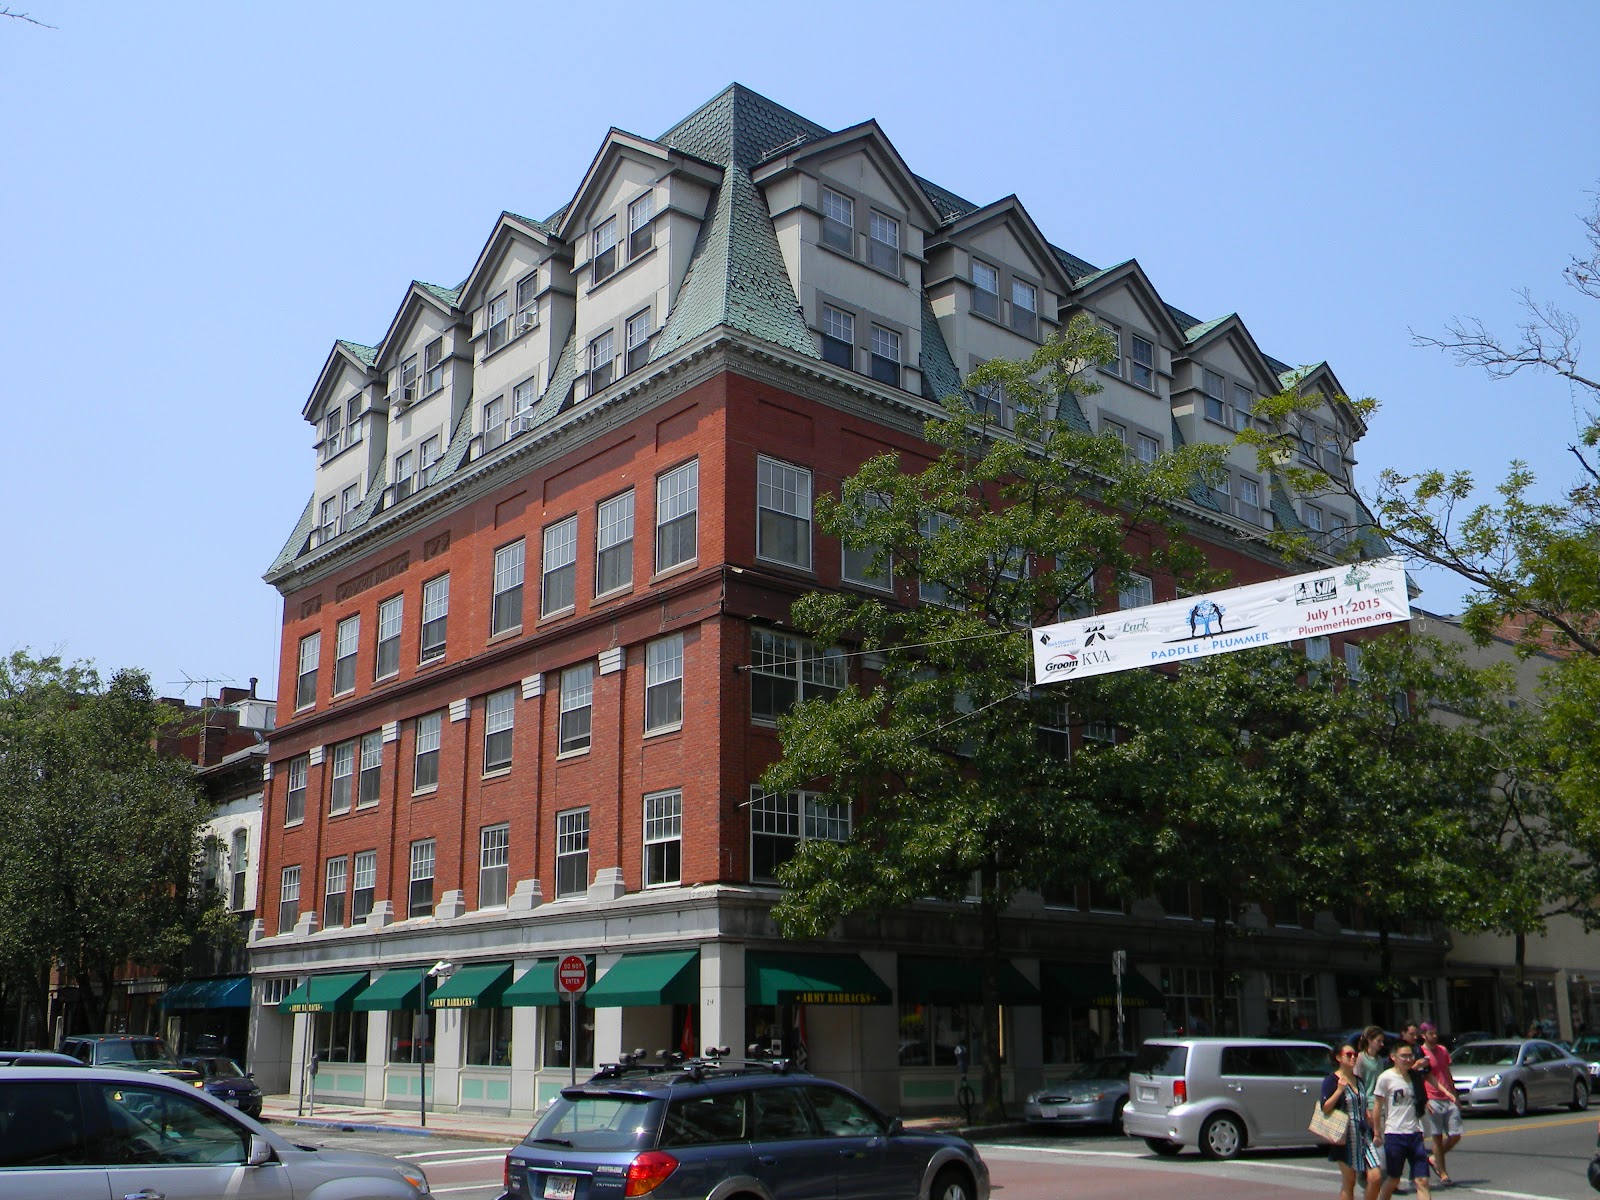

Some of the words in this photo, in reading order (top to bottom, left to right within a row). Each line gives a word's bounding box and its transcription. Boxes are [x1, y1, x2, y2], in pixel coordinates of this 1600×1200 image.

[1363, 579, 1394, 591] Plummer
[1374, 585, 1395, 595] Home
[1306, 609, 1329, 622] July
[1332, 604, 1349, 616] 11,
[1351, 597, 1381, 613] 2015
[1122, 617, 1149, 633] Lark
[1298, 611, 1393, 636] PlummerHome.org
[1151, 643, 1200, 660] PADDLE
[1212, 631, 1270, 650] PLUMMER
[1081, 650, 1111, 666] KVA
[1045, 660, 1079, 672] Groom
[433, 998, 447, 1008] ARMY
[446, 997, 472, 1007] BARRACKS
[803, 992, 825, 1004] ARMY
[827, 992, 872, 1004] BARRACKS
